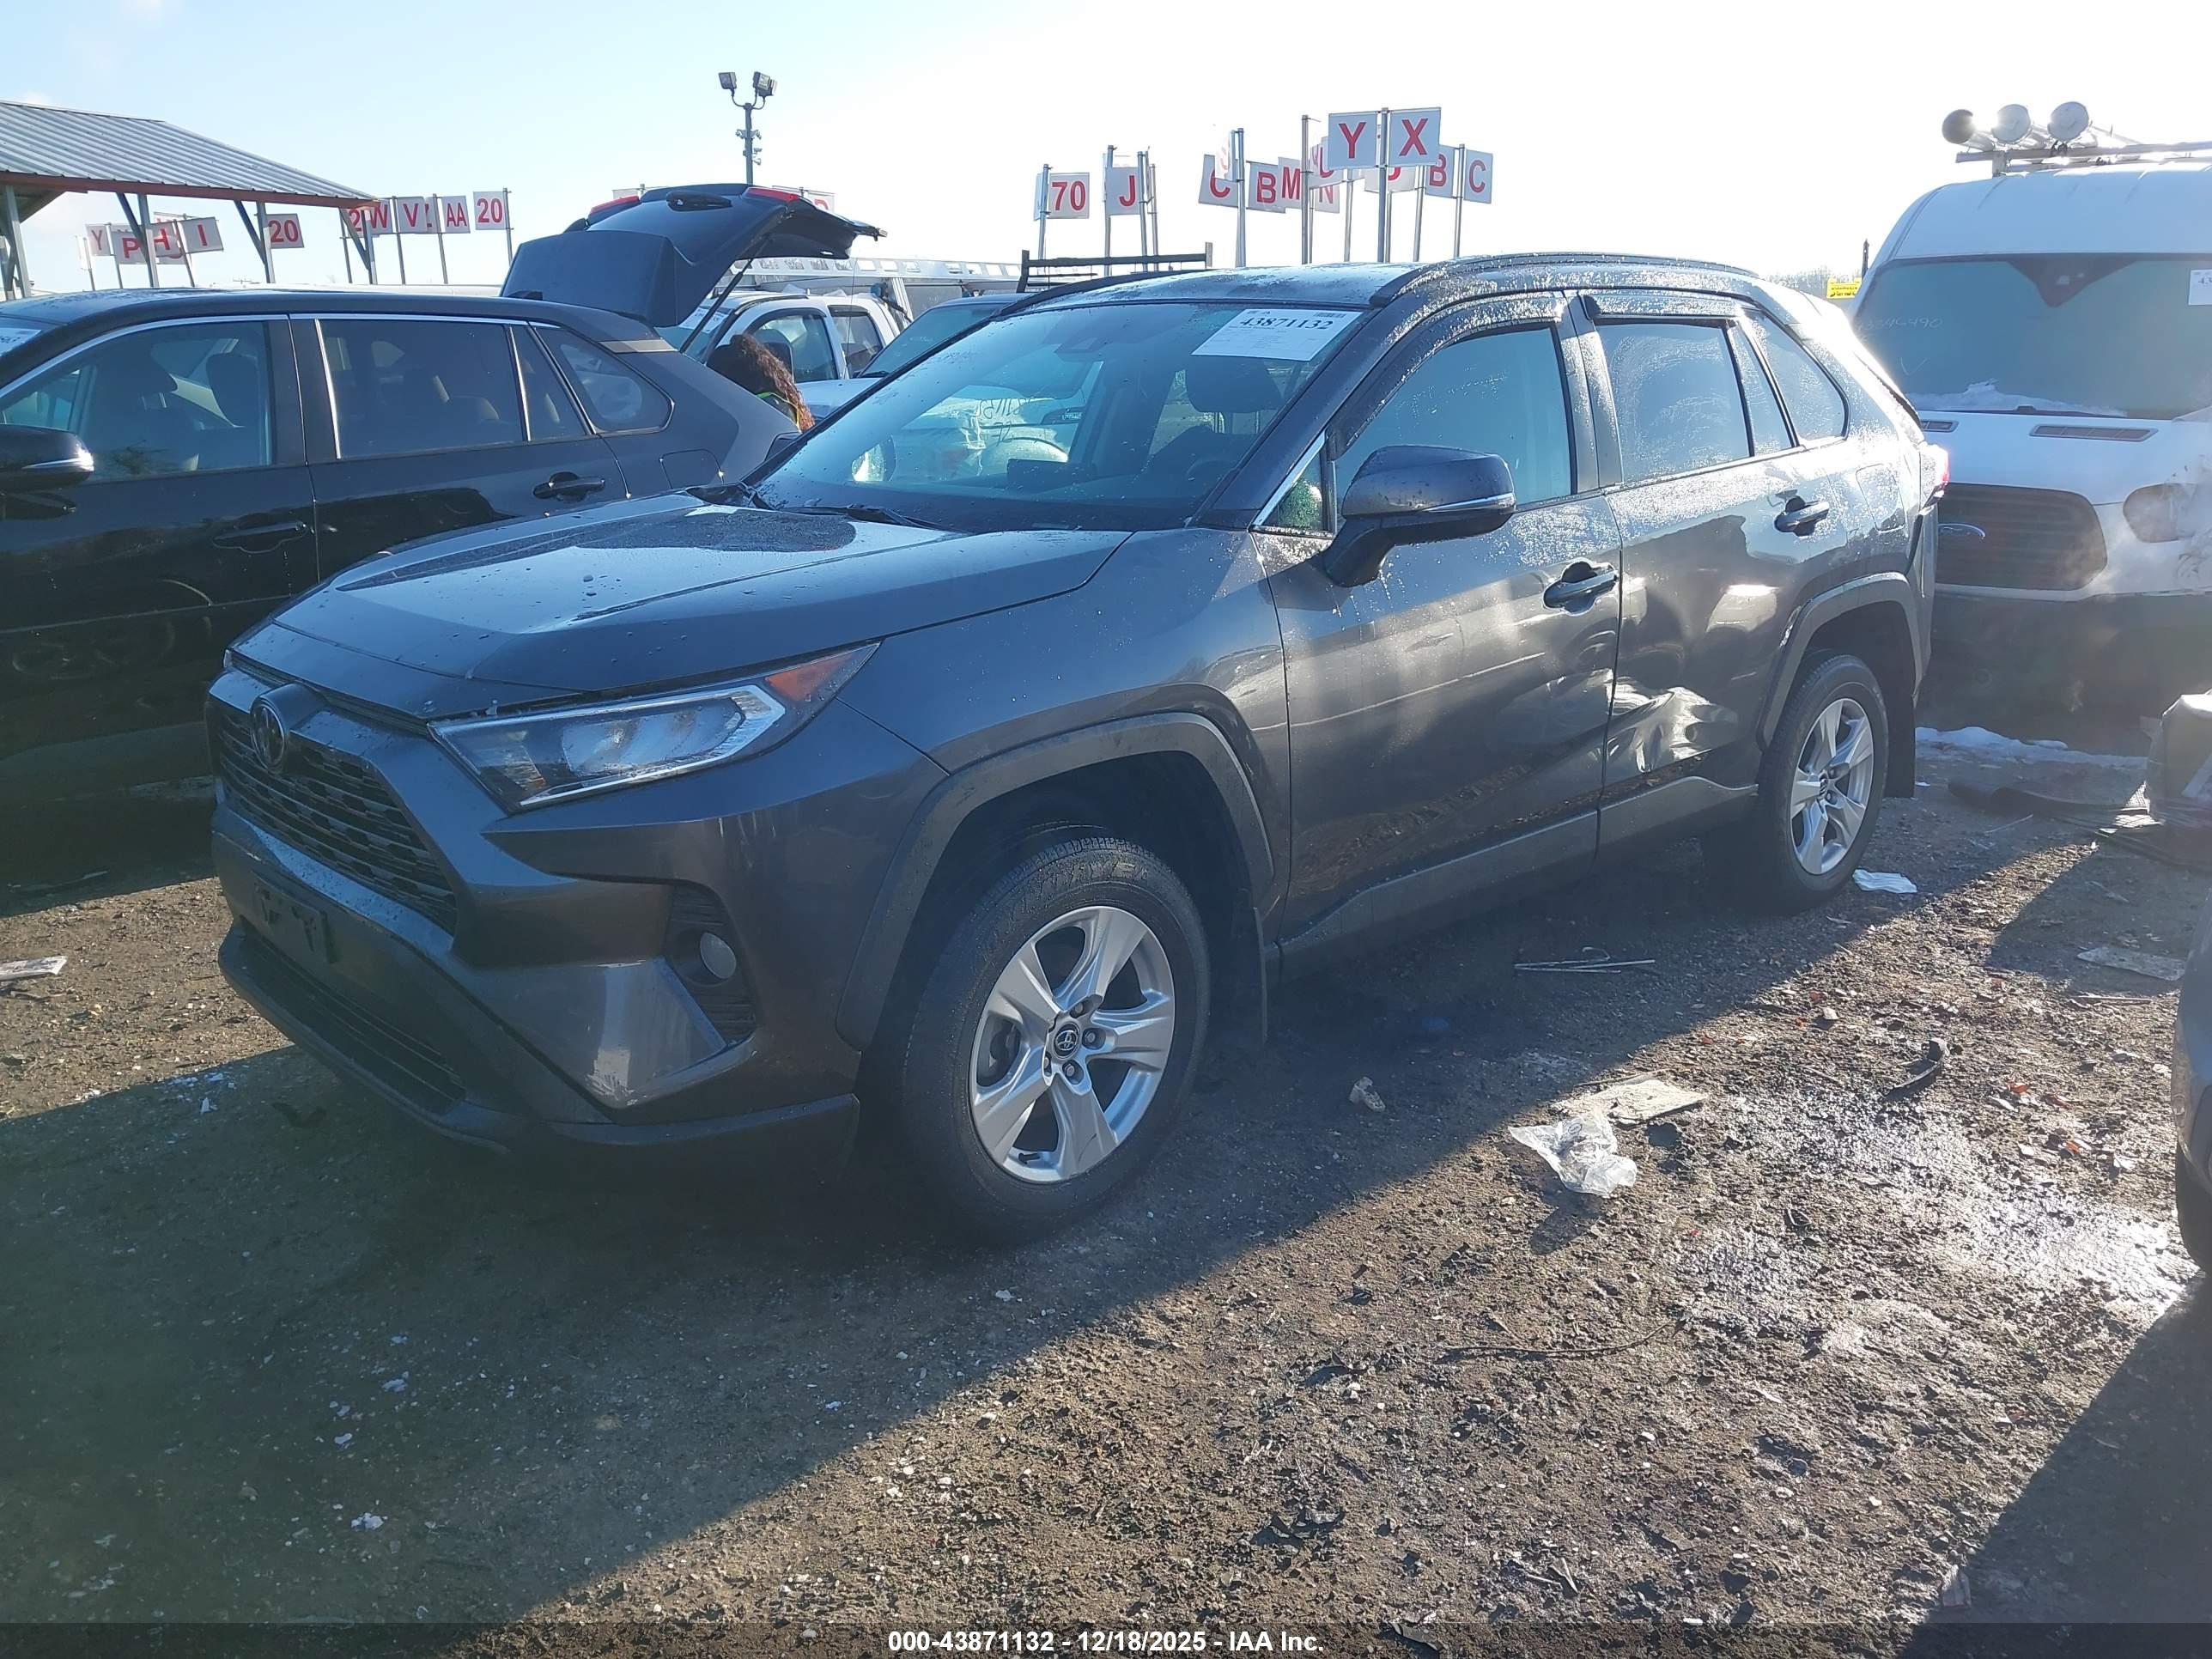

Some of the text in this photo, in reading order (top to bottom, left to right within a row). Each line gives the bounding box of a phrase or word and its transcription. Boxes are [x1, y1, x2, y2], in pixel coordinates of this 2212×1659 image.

[1338, 122, 1366, 159] Y
[1398, 118, 1429, 156] X
[1429, 153, 1447, 186] B
[1468, 160, 1486, 193] C
[1051, 180, 1086, 211] 70
[1119, 174, 1136, 207] J
[1256, 172, 1277, 204] B
[1281, 167, 1301, 199] M
[369, 203, 389, 228] W
[403, 203, 419, 228] V
[446, 203, 468, 228] AA
[477, 198, 503, 223] 20
[91, 230, 103, 251] Y
[197, 224, 208, 246] I
[270, 219, 299, 243] 20
[122, 237, 141, 259] P
[1240, 316, 1334, 330] 43871132
